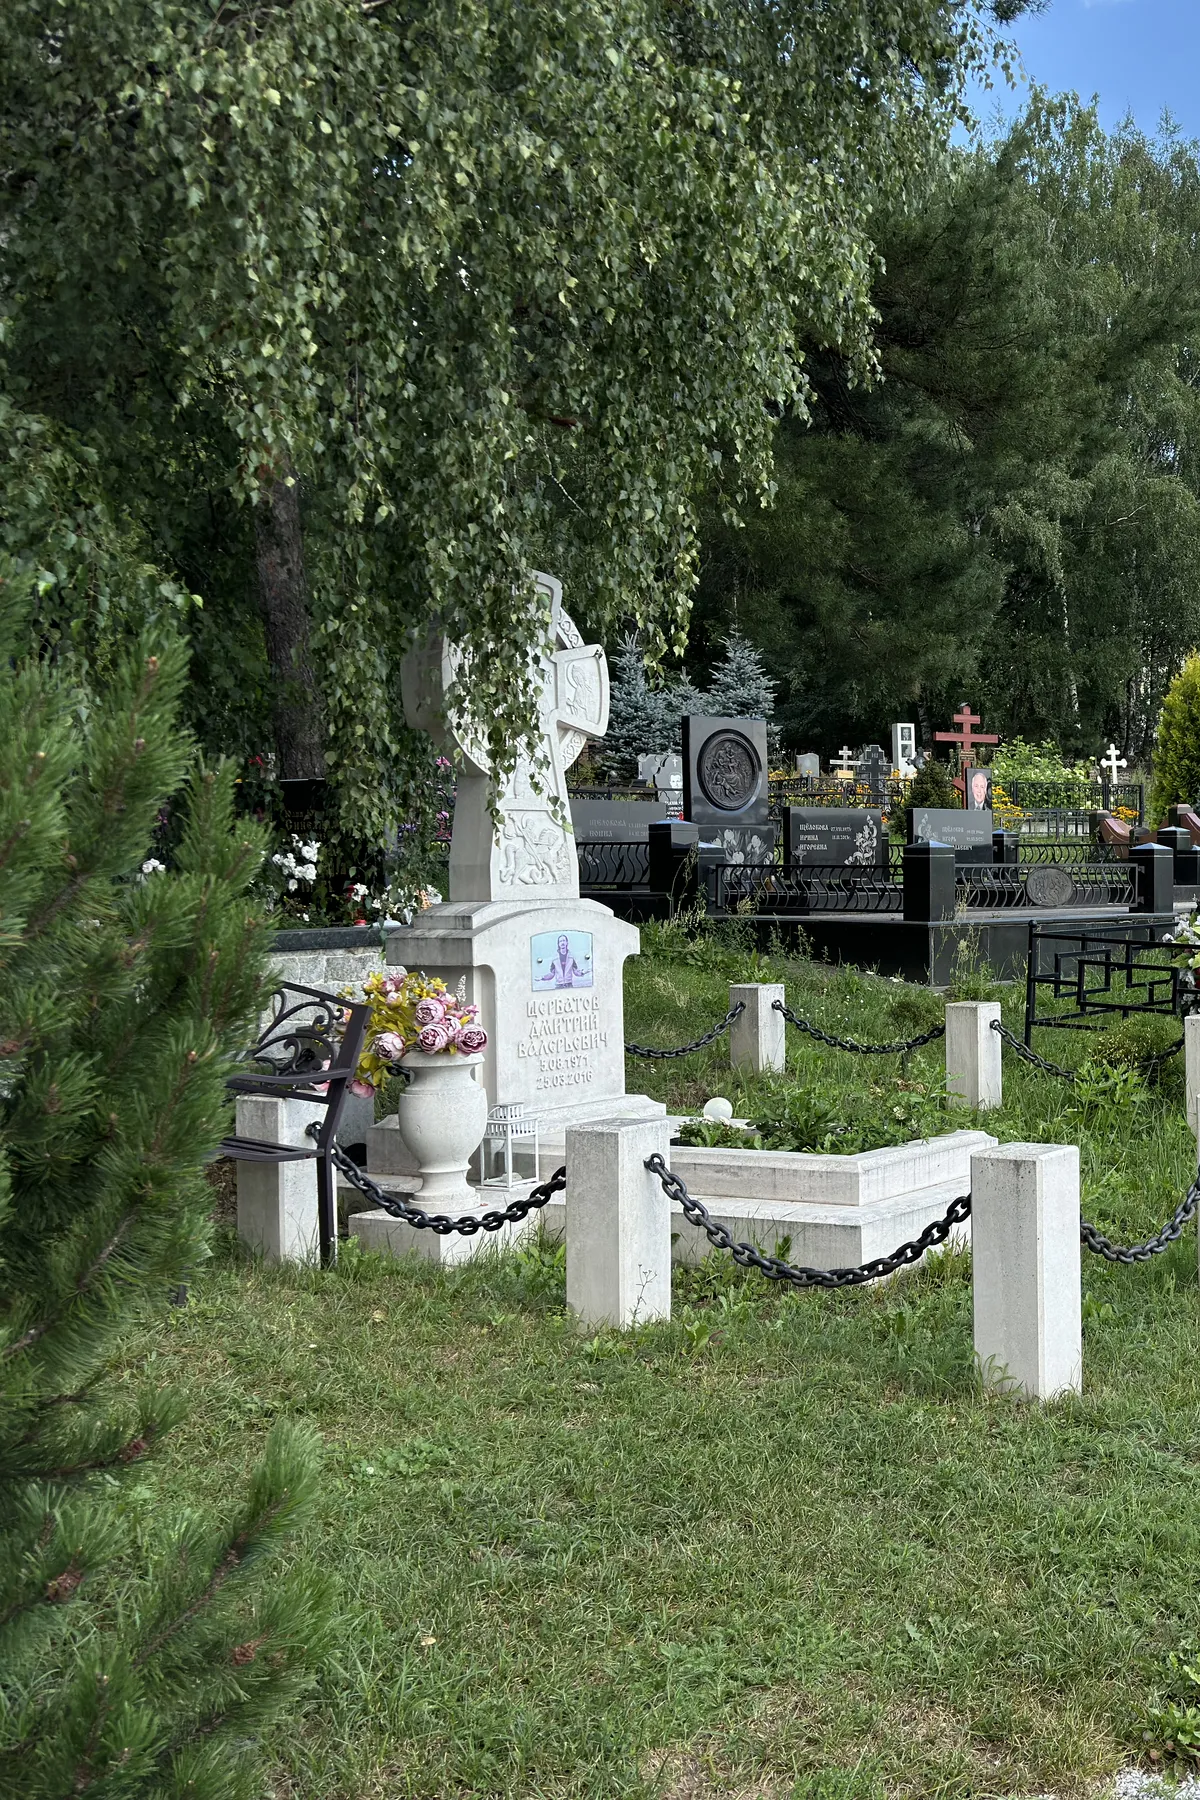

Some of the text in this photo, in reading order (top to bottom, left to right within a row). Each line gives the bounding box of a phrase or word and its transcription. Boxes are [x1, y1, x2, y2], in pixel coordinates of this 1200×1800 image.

[526, 996, 600, 1018] ЩЕРБАТОВ
[529, 1012, 598, 1039] ДМИТРИЙ
[517, 1032, 608, 1058] ВАЛЕРЬЕВИЧ
[536, 1070, 593, 1090] 25.03.2016
